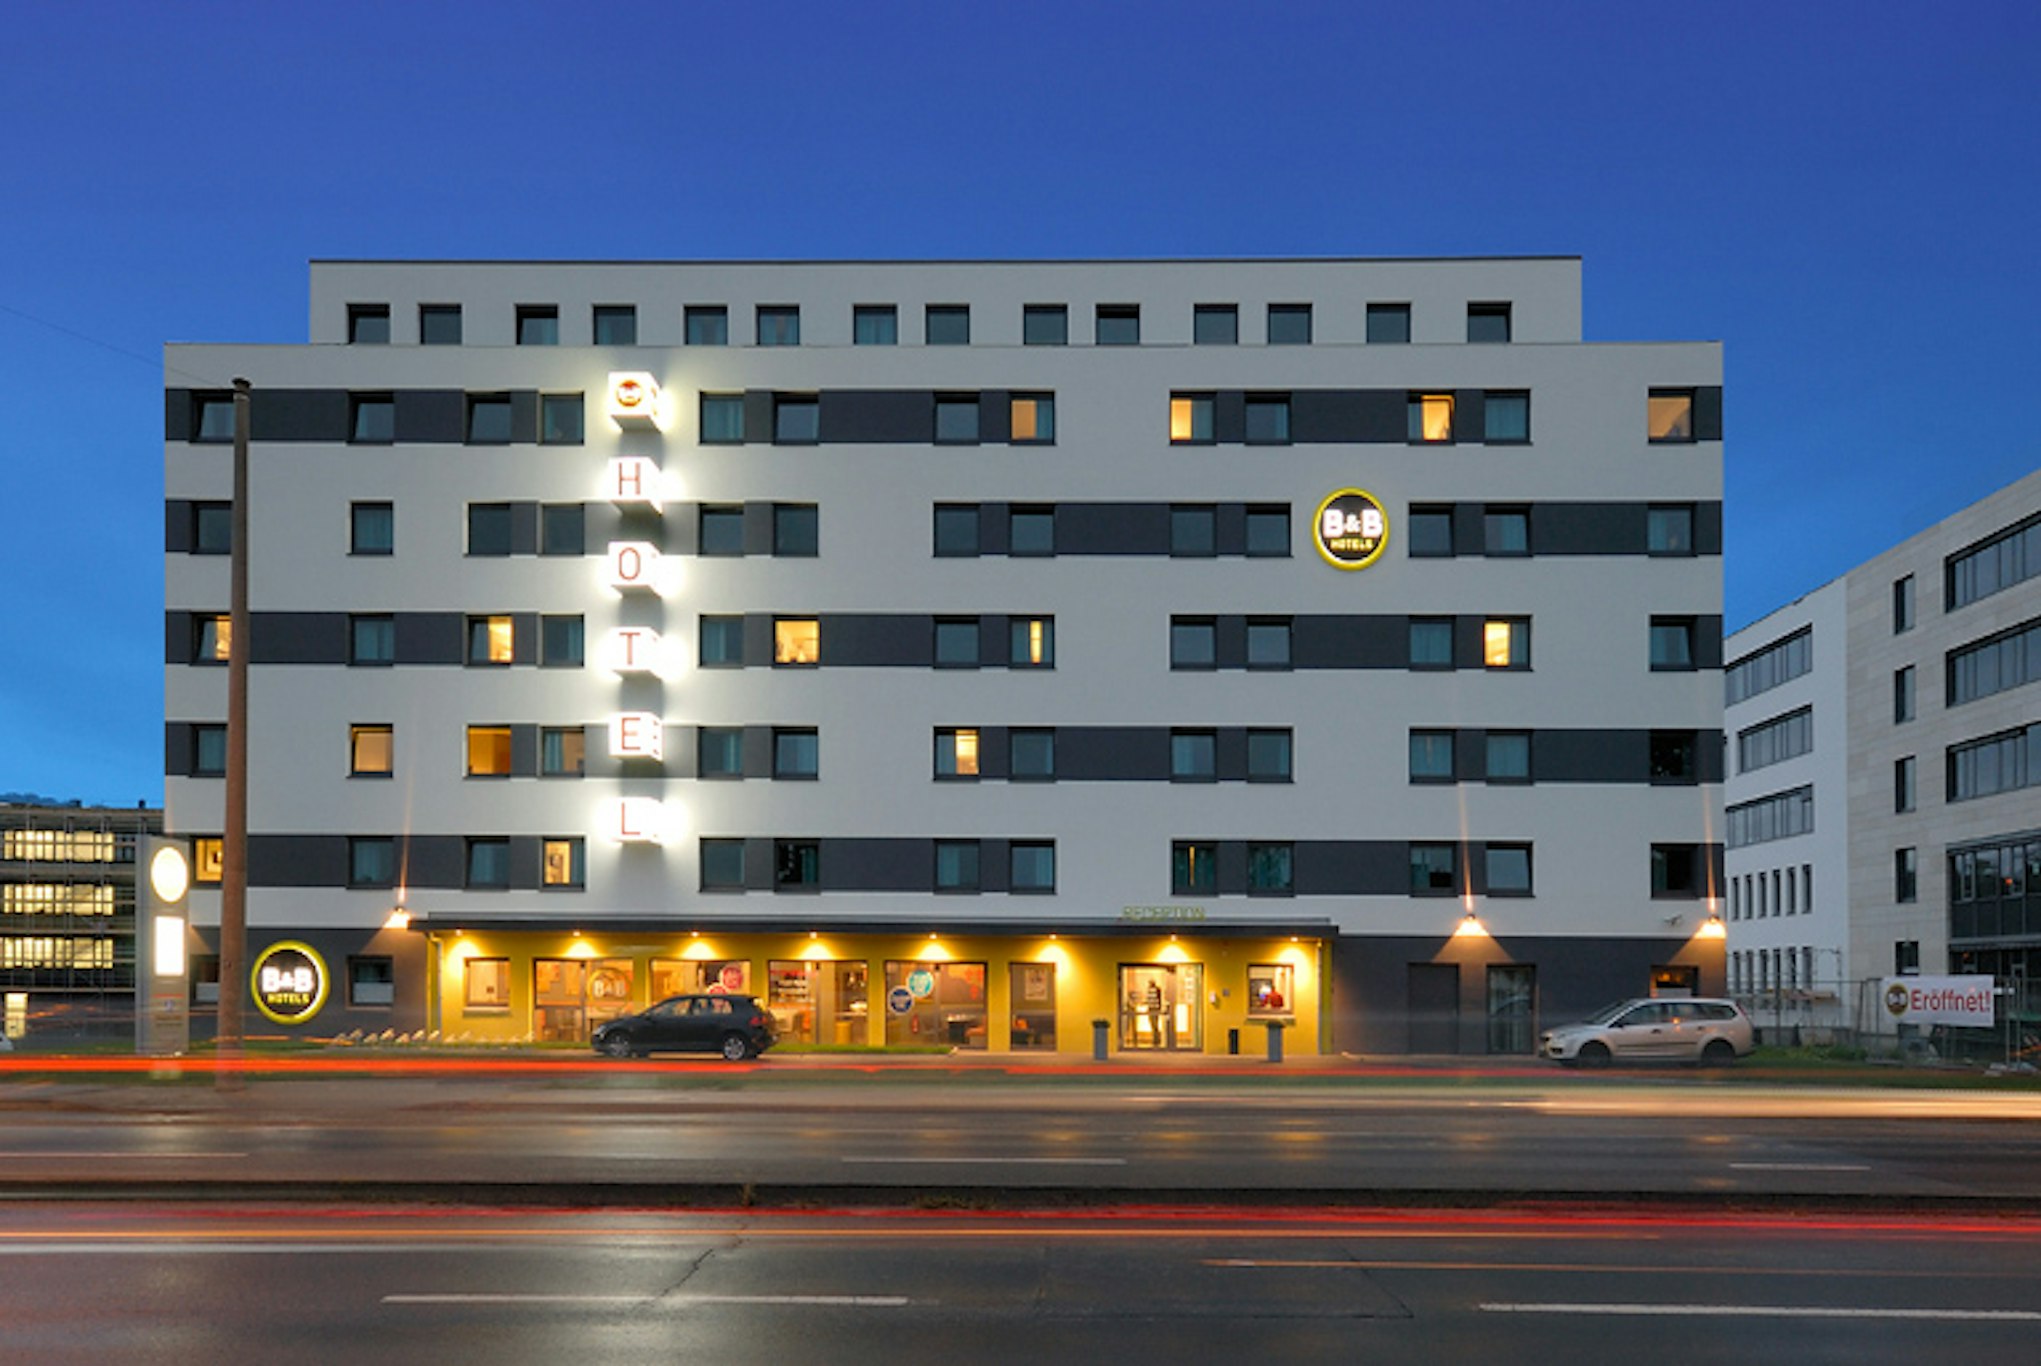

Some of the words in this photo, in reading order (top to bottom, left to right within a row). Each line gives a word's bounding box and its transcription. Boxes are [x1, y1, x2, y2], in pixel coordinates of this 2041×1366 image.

[1323, 509, 1383, 538] B&B
[1330, 538, 1373, 550] HOTELS
[618, 462, 641, 836] HOTEL
[1123, 906, 1206, 920] RECEPTION
[262, 966, 314, 993] B&B
[267, 993, 310, 1004] HOTELS
[1911, 987, 1992, 1012] Eröffnet!
